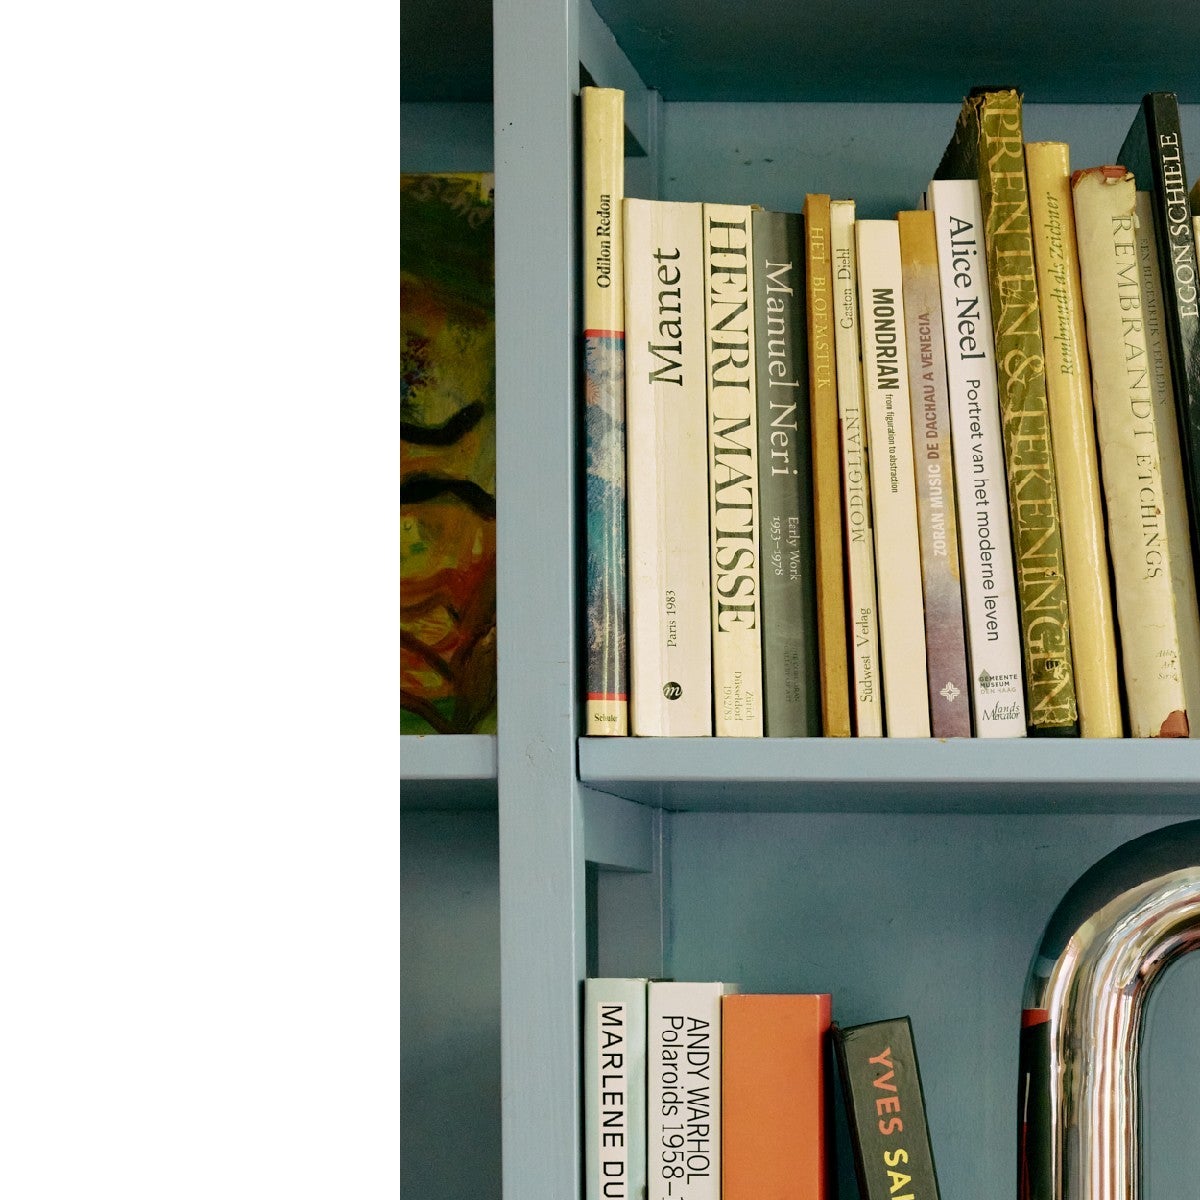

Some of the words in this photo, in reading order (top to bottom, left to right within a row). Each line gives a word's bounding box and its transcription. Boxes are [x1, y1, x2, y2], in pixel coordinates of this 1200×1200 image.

[599, 194, 611, 235] Redon
[1160, 131, 1190, 235] SCHIELE
[811, 227, 824, 267] HET
[949, 216, 977, 288] Alice
[983, 106, 1041, 338] PRENTEN
[597, 238, 611, 288] Odilon
[838, 248, 851, 280] Diehl
[1171, 245, 1199, 318] EGON
[648, 247, 682, 387] Manet
[709, 216, 750, 393] HENRI
[765, 260, 800, 388] Manuel
[813, 277, 829, 389] BLOEMSTUK
[840, 288, 854, 329] Gaston
[955, 297, 985, 360] Neel
[1050, 286, 1074, 376] Rembrandt
[872, 288, 899, 390] MONDRIAN
[918, 312, 935, 367] VENECIA
[924, 388, 939, 439] DACHAU
[966, 379, 981, 438] Portret
[1112, 214, 1156, 438] REMBRANDT
[1136, 453, 1164, 580] ETCHINGS
[769, 401, 798, 476] Neri
[926, 442, 939, 460] DE
[970, 444, 986, 472] van
[929, 464, 941, 505] MUSIC
[973, 477, 989, 504] het
[713, 413, 756, 633] MATISSE
[786, 517, 799, 547] Early
[845, 406, 866, 544] MODIGLIANI
[856, 608, 870, 648] Verlag
[933, 507, 947, 556] ZORAN
[976, 510, 995, 591] moderne
[790, 549, 801, 580] Work
[667, 590, 676, 613] 1983
[667, 616, 677, 648] Paris
[984, 596, 999, 642] leven
[600, 1004, 626, 1149] MARLENE
[661, 1014, 685, 1119] Polaroids
[685, 1016, 710, 1080] ANDY
[868, 1046, 903, 1137] YVES
[685, 1082, 711, 1185] WARHOL
